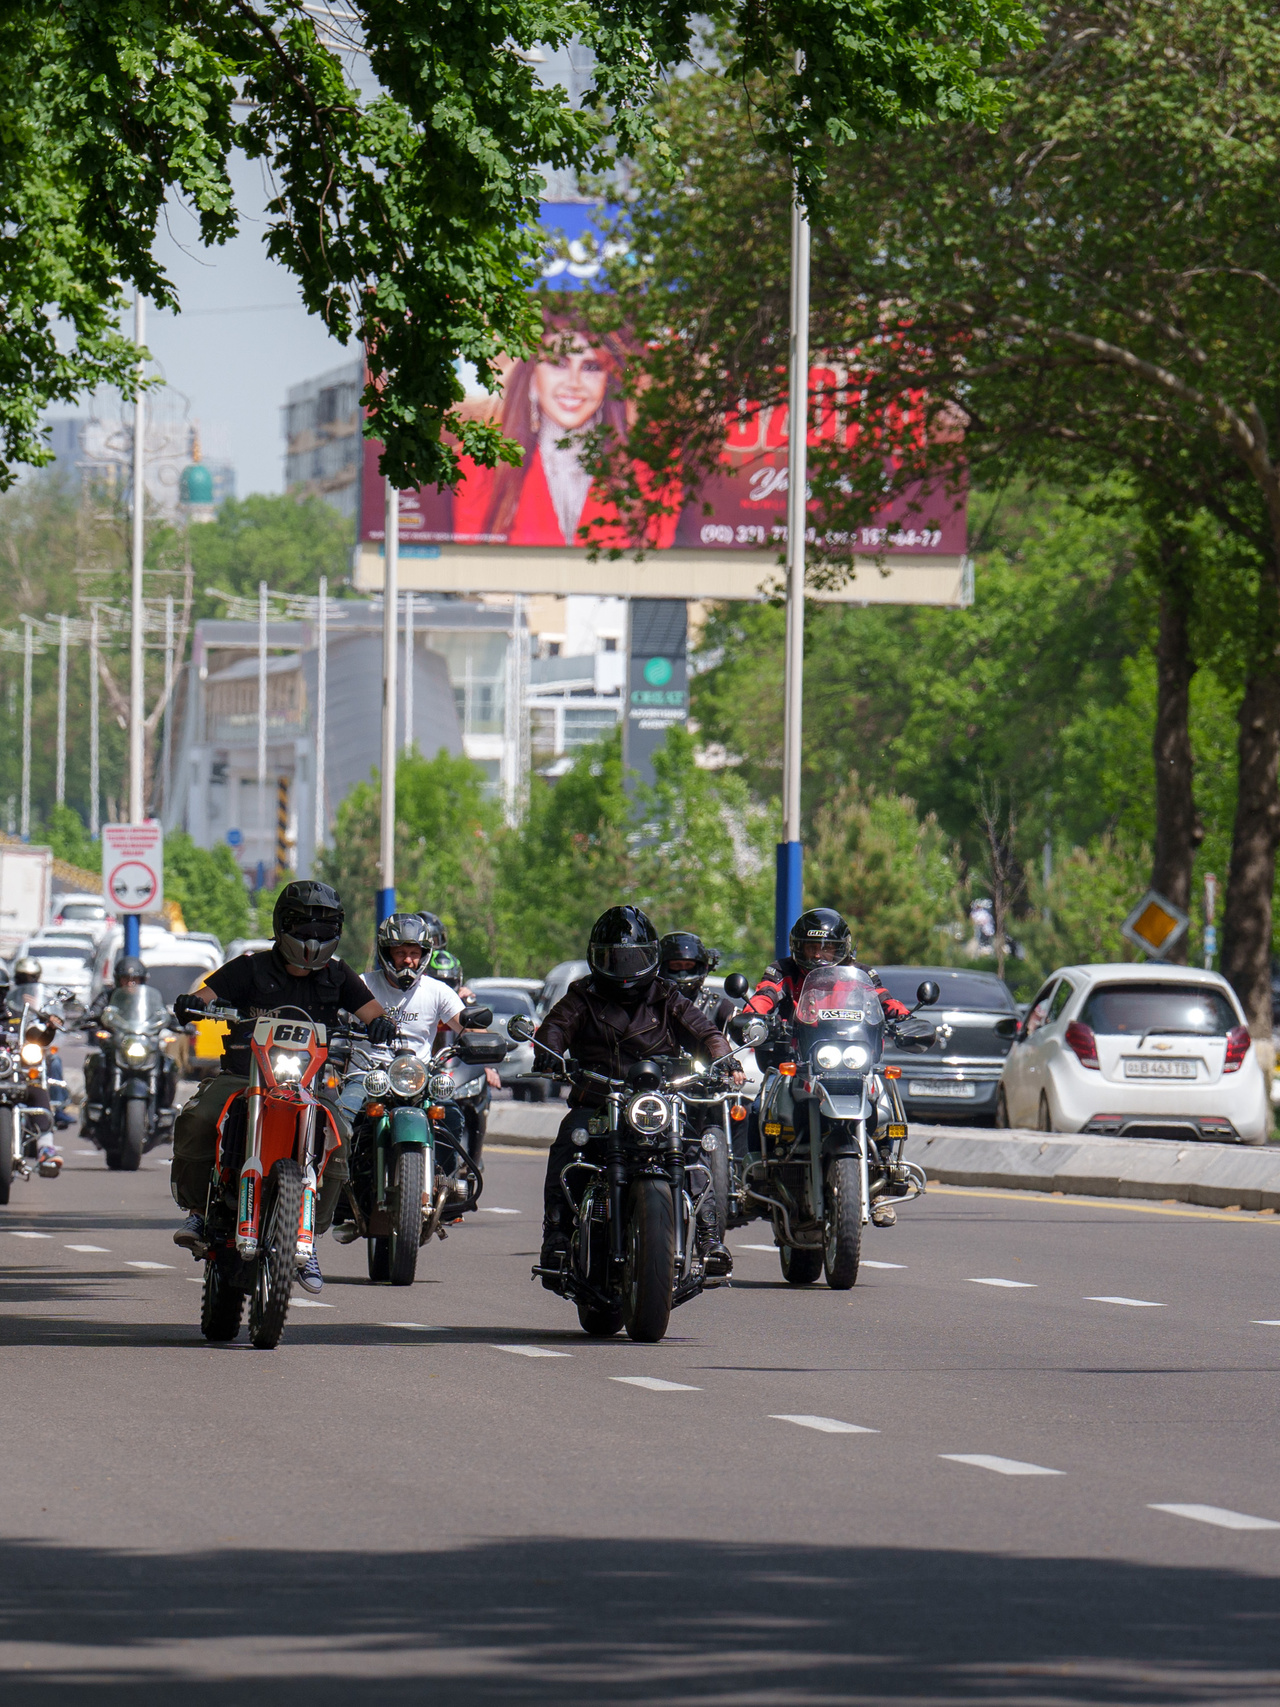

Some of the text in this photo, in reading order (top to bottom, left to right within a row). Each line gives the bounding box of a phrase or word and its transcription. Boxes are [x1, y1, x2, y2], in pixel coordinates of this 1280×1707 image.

[249, 1006, 281, 1018] SWAT
[401, 1011, 419, 1021] RIDE
[274, 1025, 310, 1044] 68
